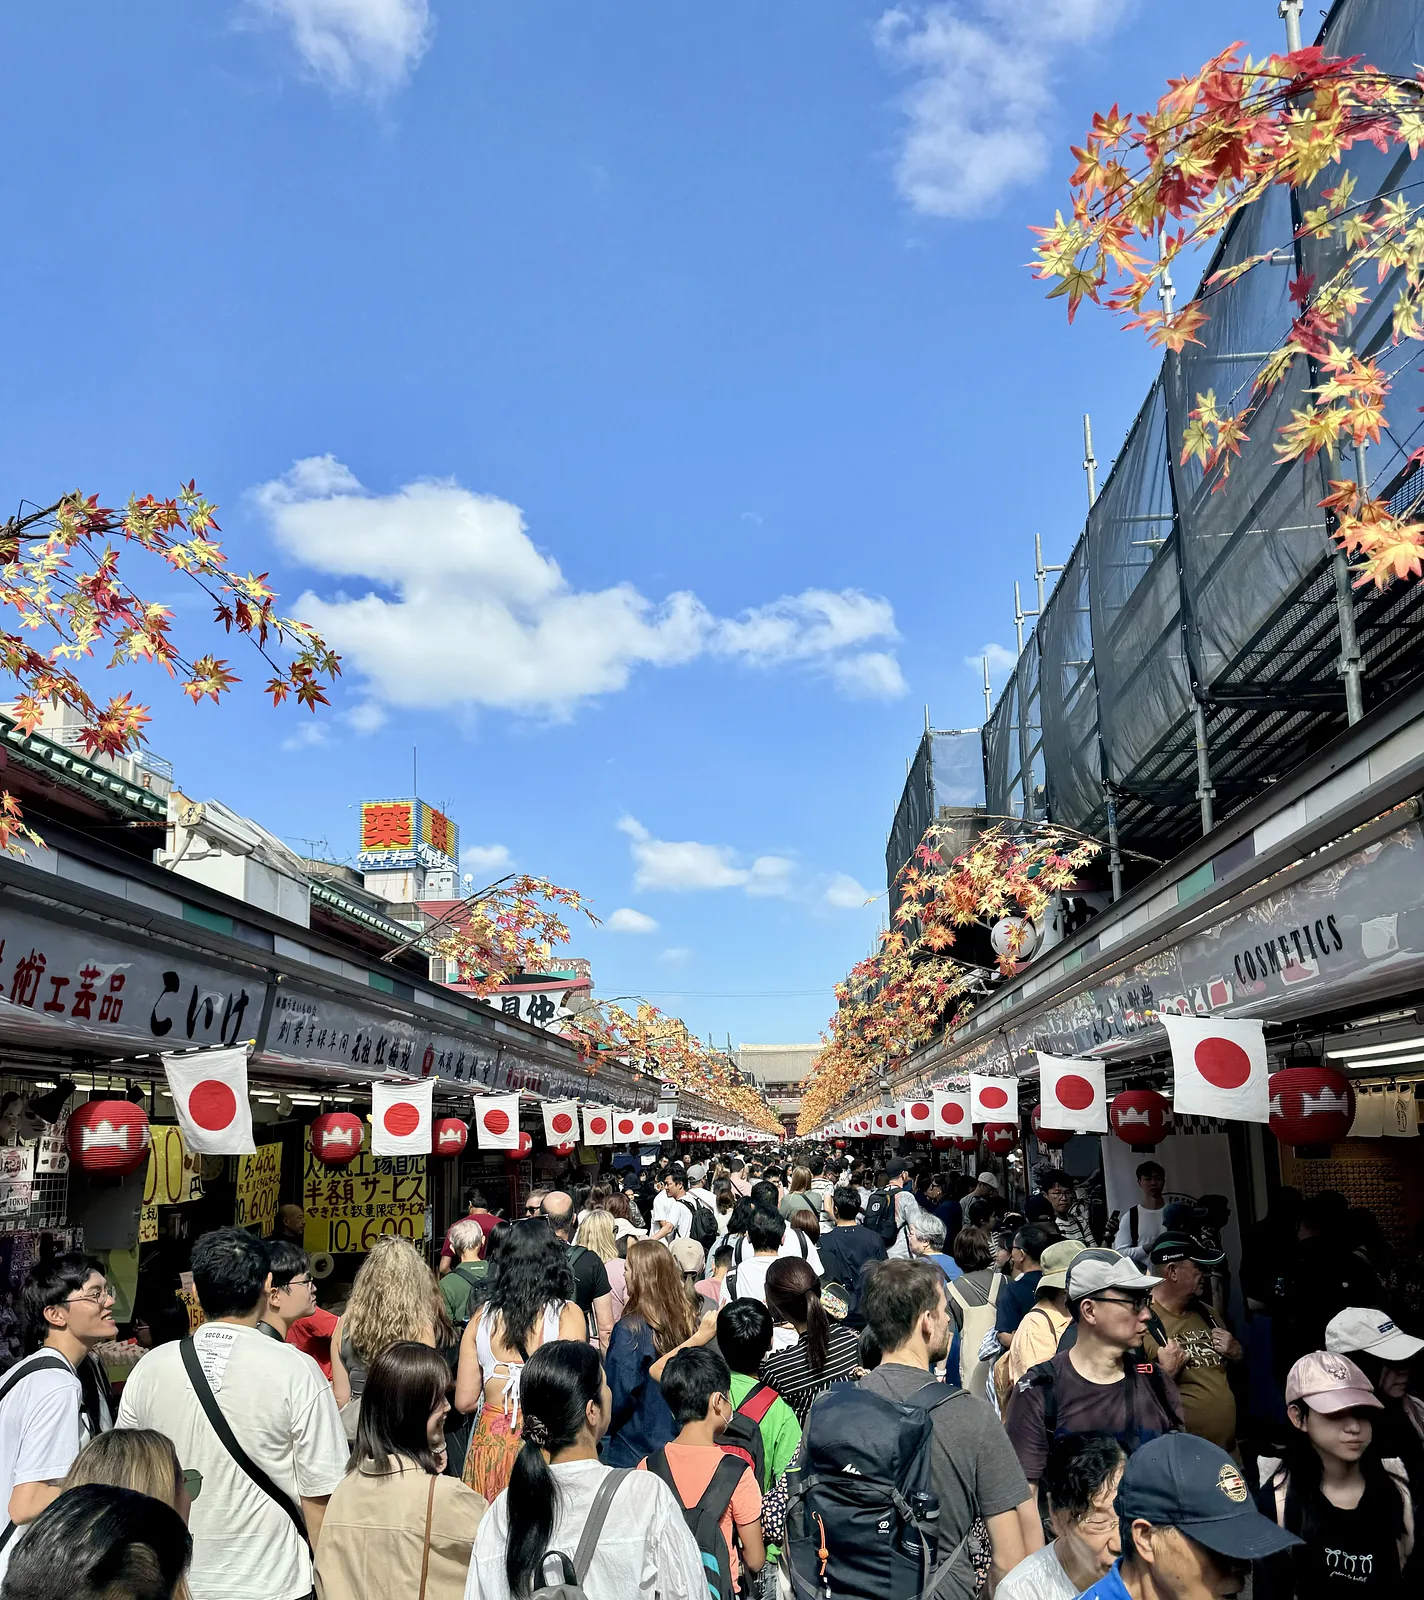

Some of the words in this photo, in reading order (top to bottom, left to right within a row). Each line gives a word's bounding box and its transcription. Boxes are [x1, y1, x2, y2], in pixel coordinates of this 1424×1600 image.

[364, 804, 411, 848] 薬
[1233, 913, 1343, 994] COSMETICS
[0, 939, 126, 1023] 術工芸品
[150, 970, 250, 1046] こいけ
[9, 1197, 29, 1207] TOKYO
[304, 1176, 426, 1206] 半額サービス
